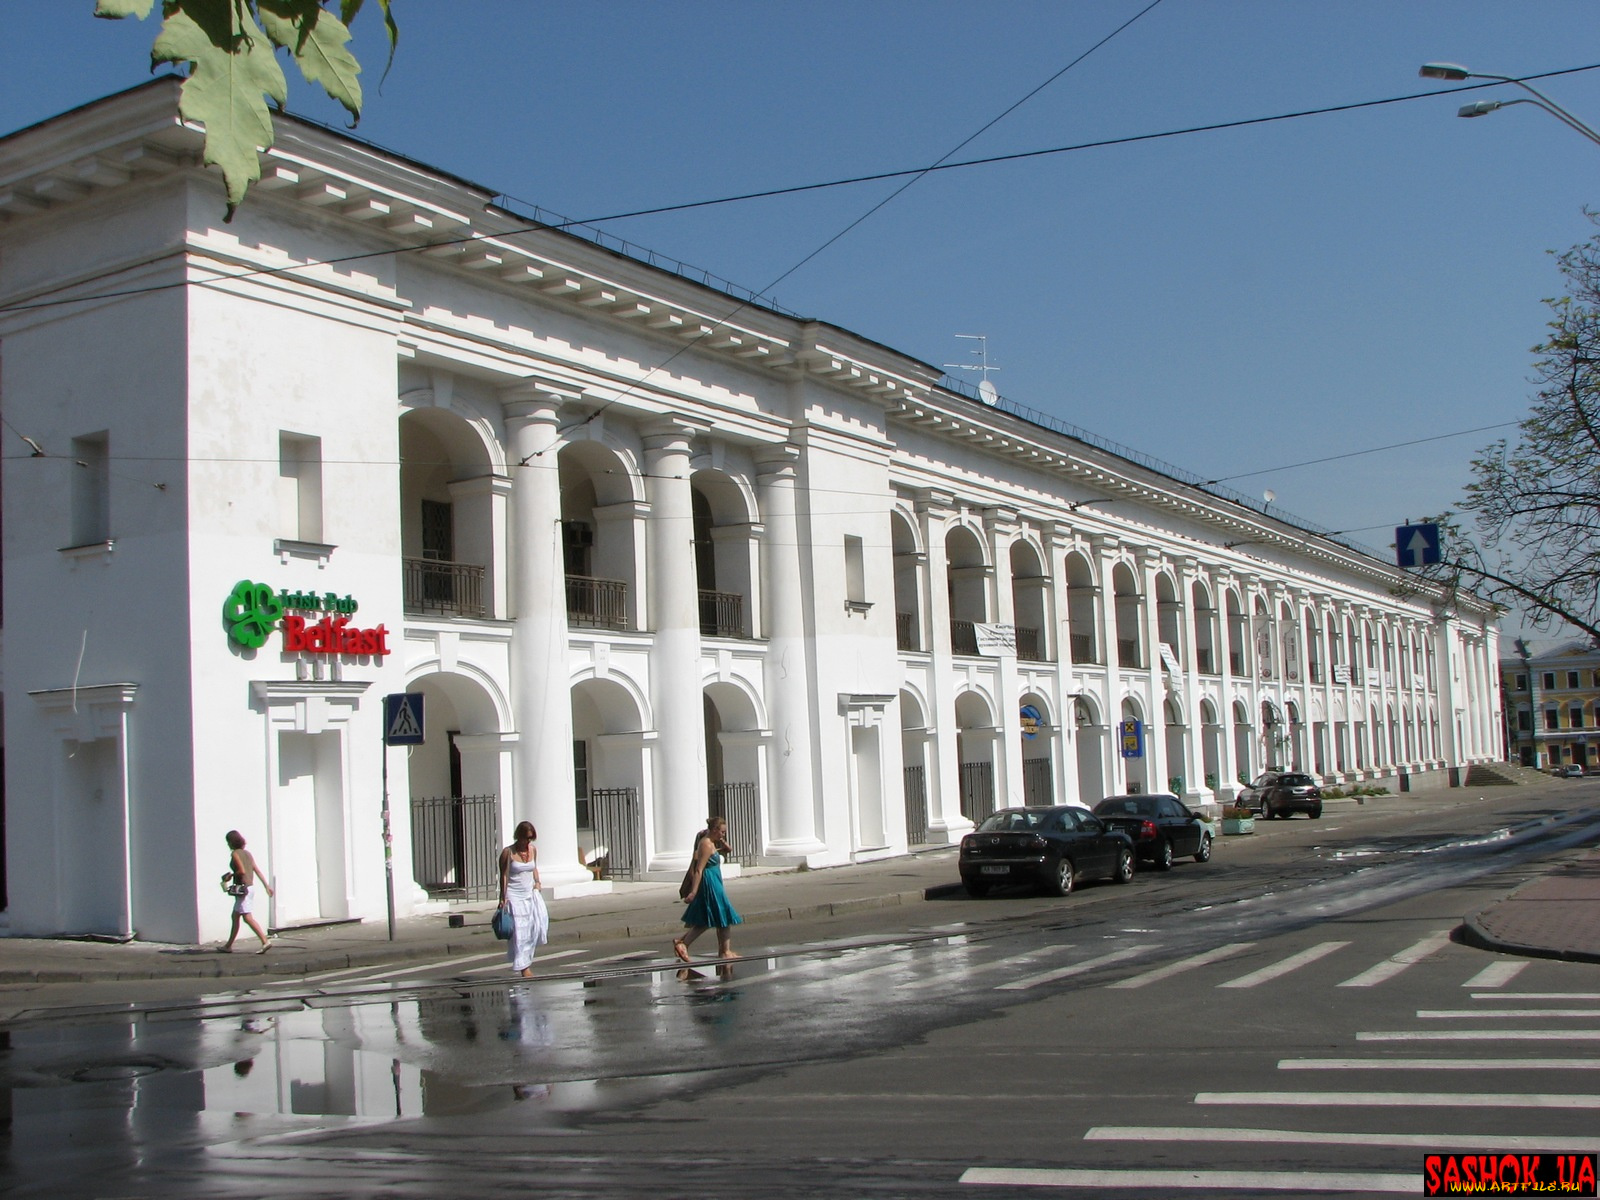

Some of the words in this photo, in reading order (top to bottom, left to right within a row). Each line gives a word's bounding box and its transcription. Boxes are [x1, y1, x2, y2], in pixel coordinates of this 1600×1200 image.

[280, 589, 321, 610] Irish
[323, 592, 358, 614] Pub
[282, 615, 391, 655] Belfast
